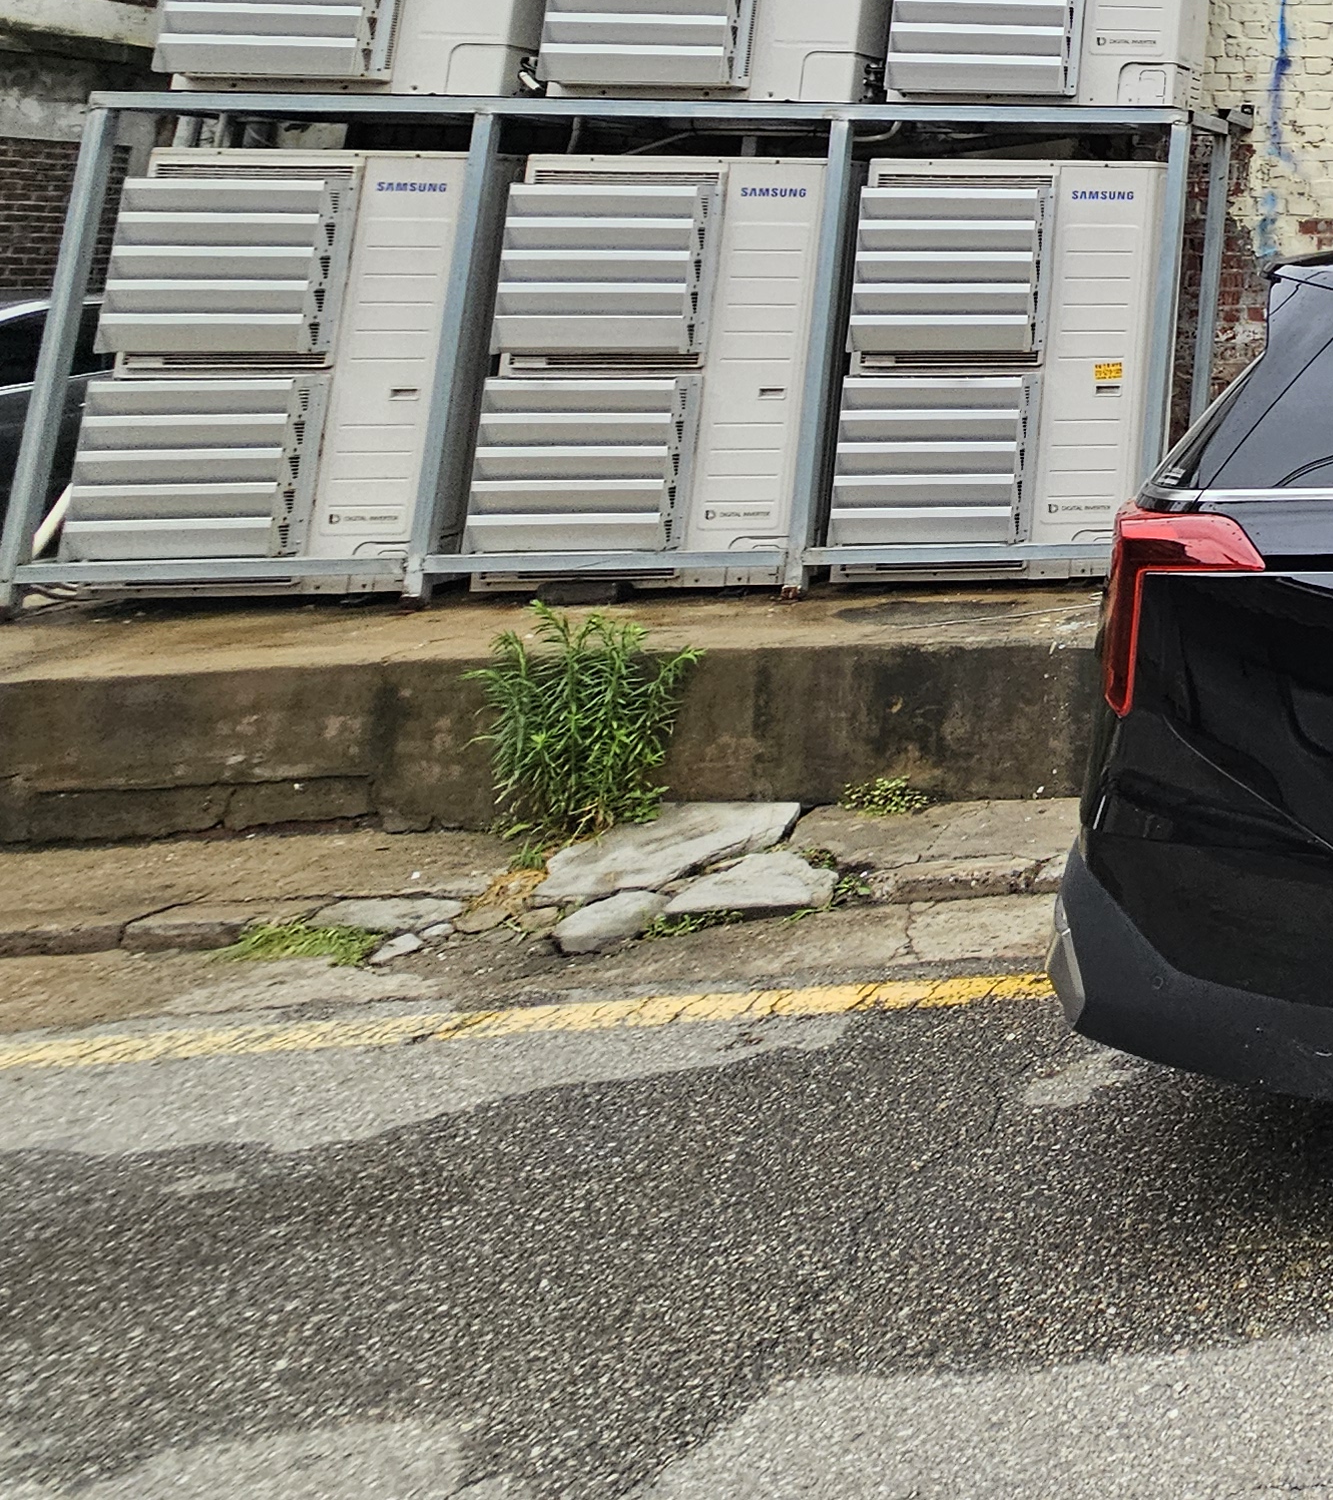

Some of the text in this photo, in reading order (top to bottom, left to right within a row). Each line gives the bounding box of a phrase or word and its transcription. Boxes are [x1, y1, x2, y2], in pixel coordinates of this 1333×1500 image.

[376, 181, 447, 193] SAMSUNG
[741, 187, 807, 198] SAMSUNG
[1071, 190, 1134, 200] SAMSUNG
